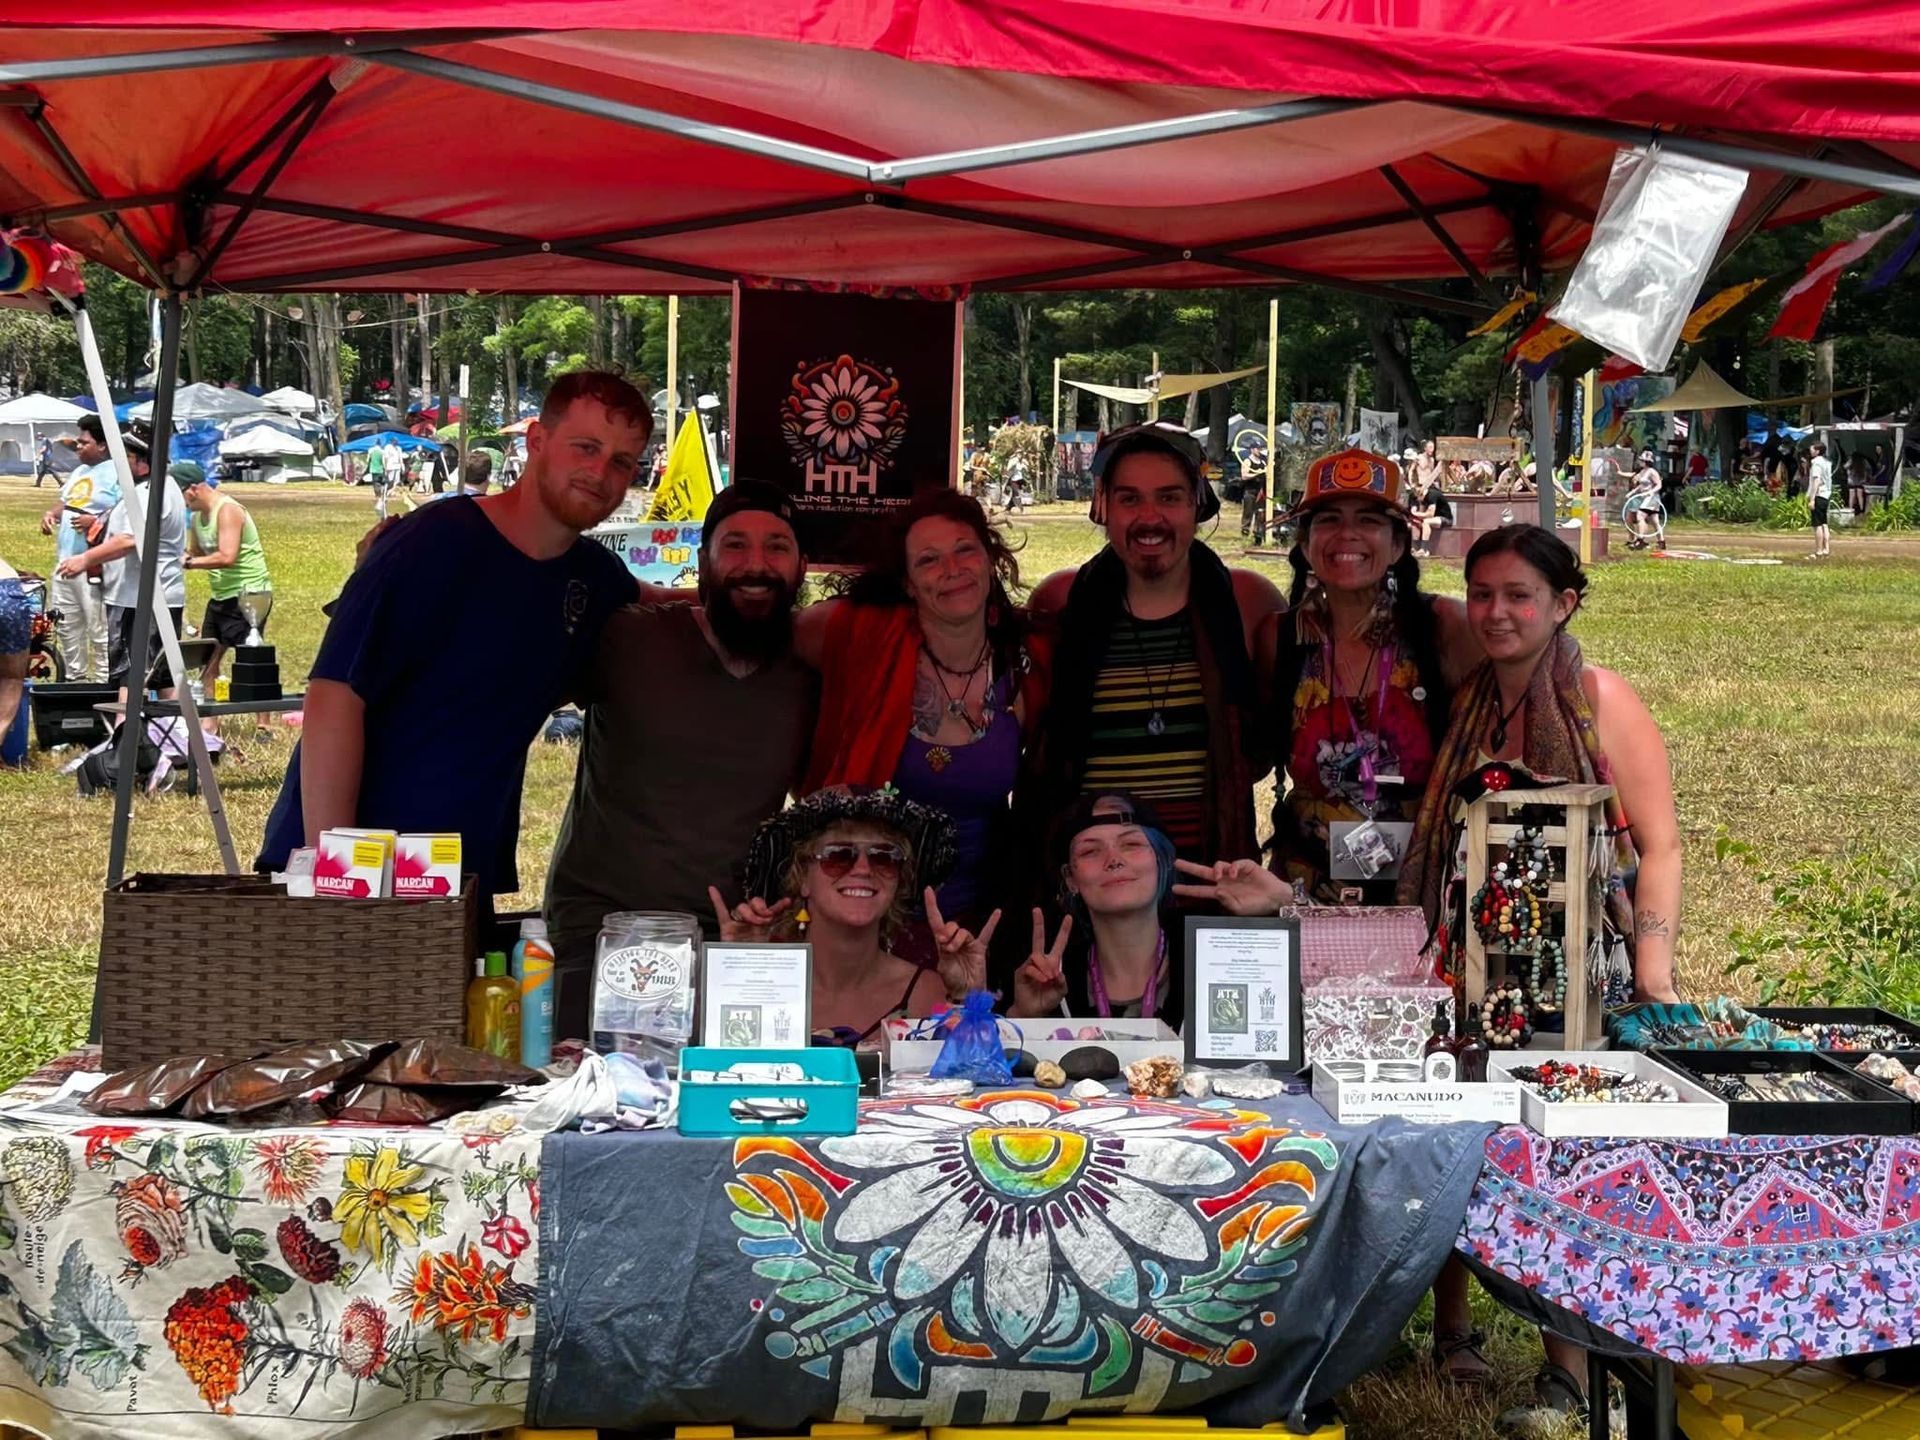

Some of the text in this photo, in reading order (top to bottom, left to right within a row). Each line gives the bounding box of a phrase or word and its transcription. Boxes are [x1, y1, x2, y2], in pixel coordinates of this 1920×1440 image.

[805, 457, 877, 494] HTH
[835, 496, 870, 505] THE
[316, 876, 355, 890] NARCAN
[396, 877, 434, 888] NARCAN
[1371, 1092, 1463, 1102] MACANUDO
[267, 1365, 280, 1404] Phlox
